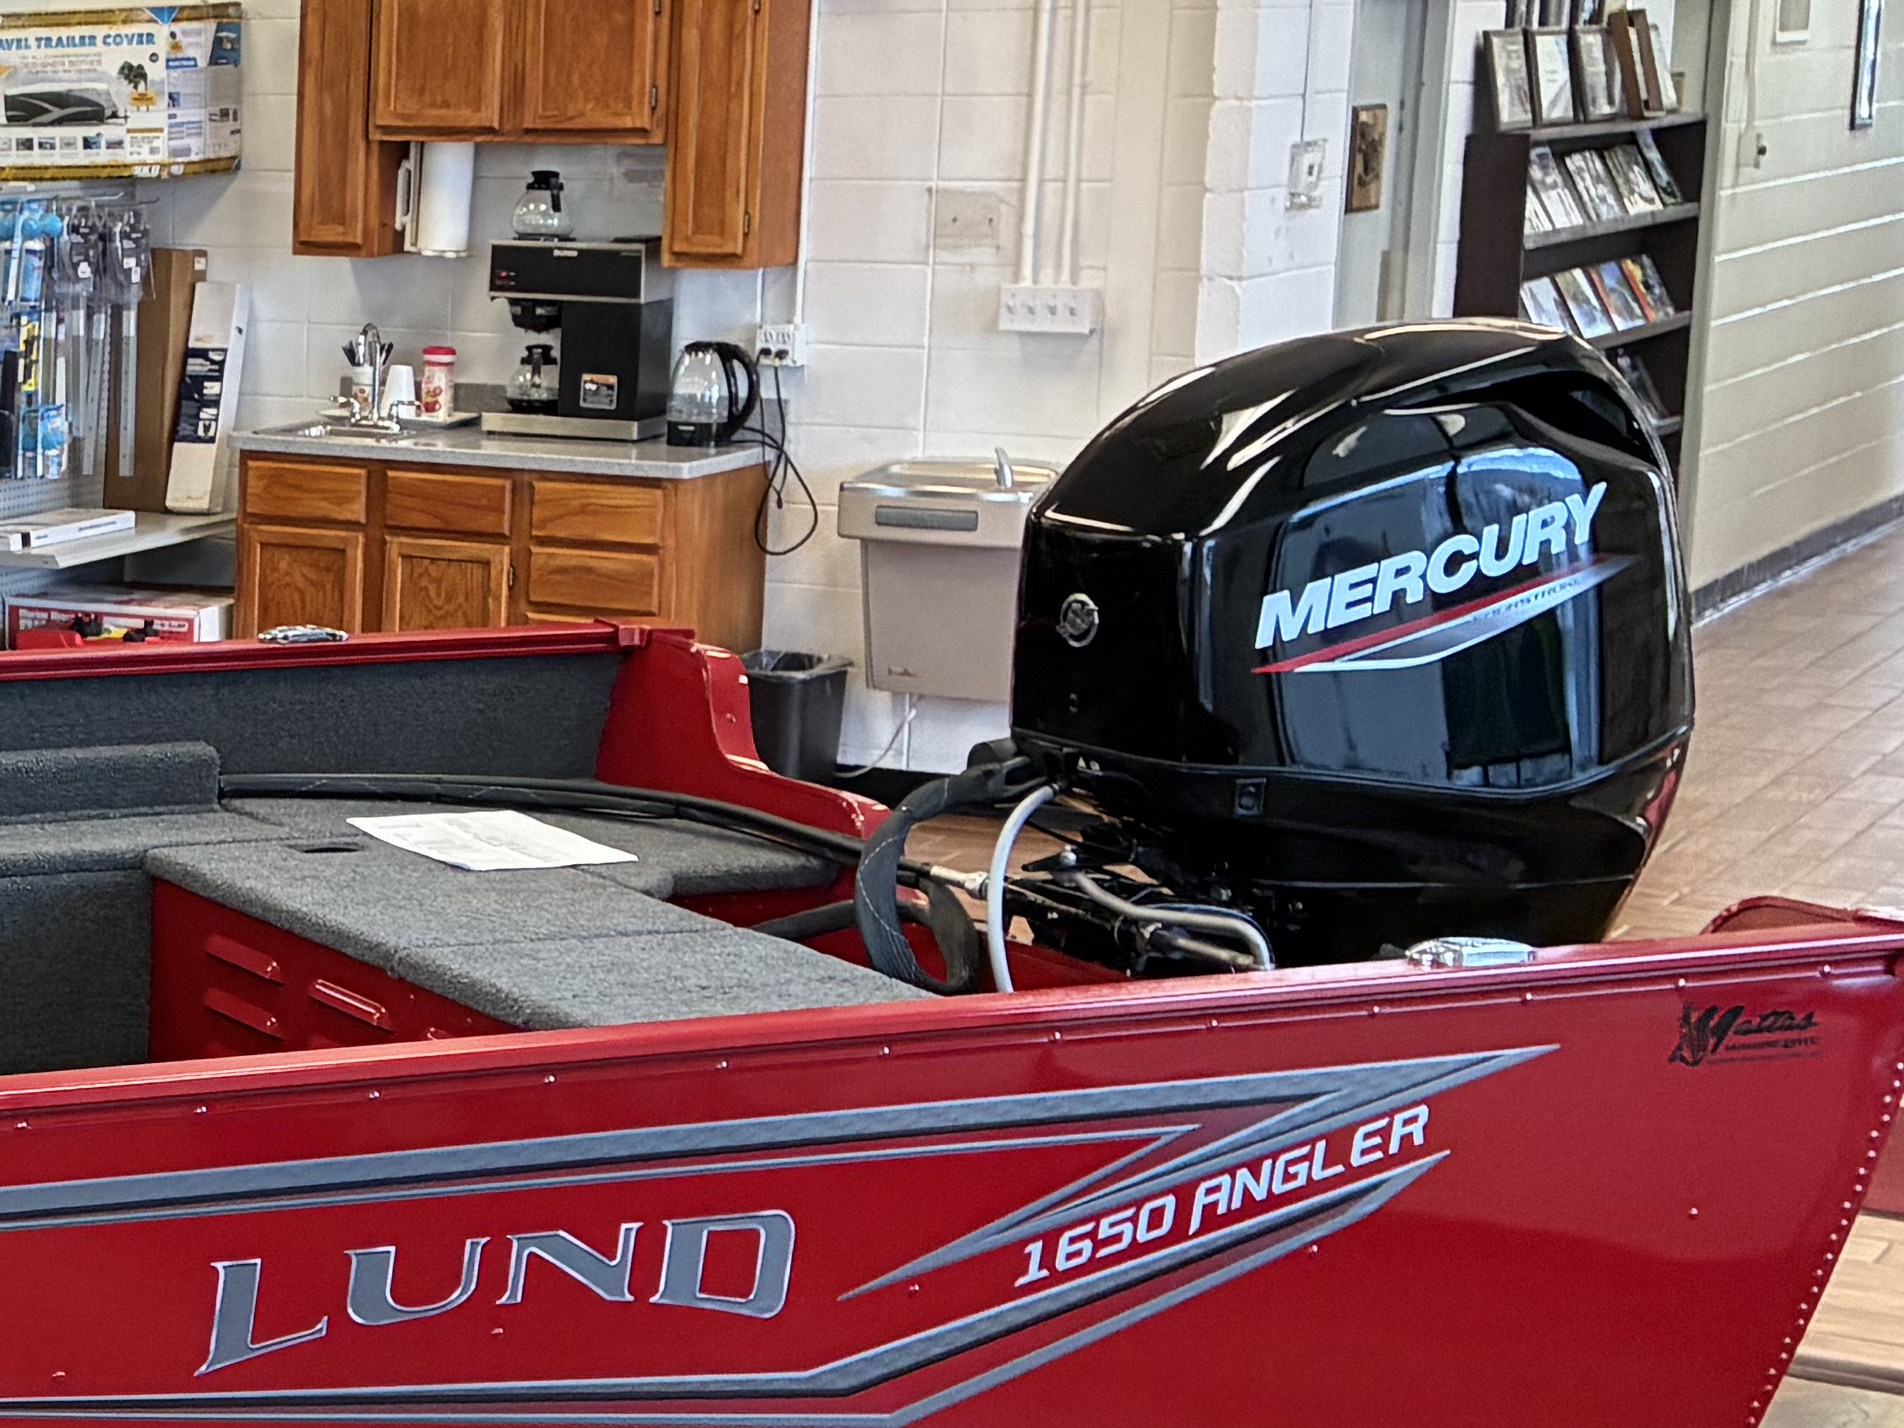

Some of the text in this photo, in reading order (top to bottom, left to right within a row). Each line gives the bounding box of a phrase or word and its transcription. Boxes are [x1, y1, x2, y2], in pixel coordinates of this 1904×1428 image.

[35, 35, 98, 50] TRAILER
[102, 32, 156, 47] COVER
[1254, 481, 1608, 651] MERCURY
[1013, 1103, 1430, 1287] 1650 ANGLER
[193, 1209, 796, 1378] LUND
